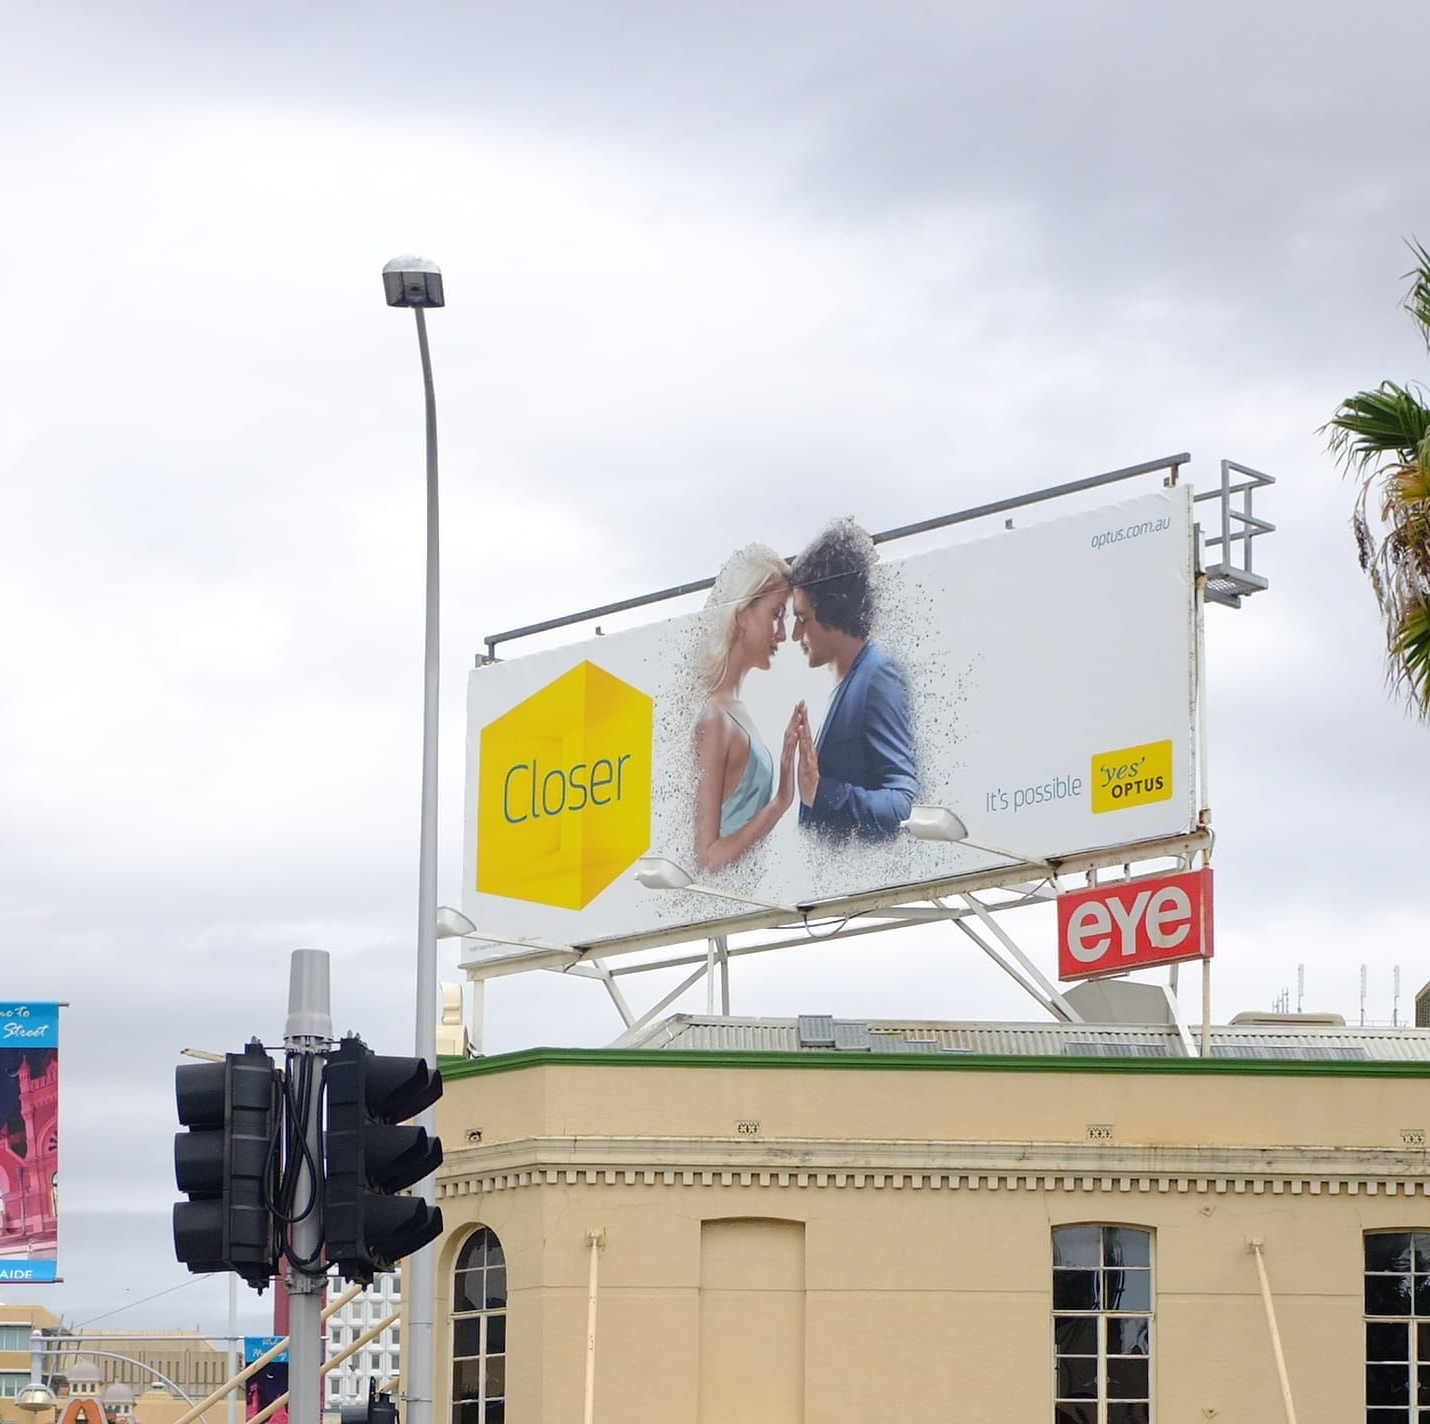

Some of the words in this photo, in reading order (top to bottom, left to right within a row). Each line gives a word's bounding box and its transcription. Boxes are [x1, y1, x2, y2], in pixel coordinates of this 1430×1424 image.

[1091, 516, 1171, 550] optus.com.au
[504, 754, 632, 824] Closer
[986, 788, 1009, 813] It's
[1014, 774, 1083, 814] possible
[1111, 776, 1165, 799] OPTUS
[3, 1022, 49, 1039] Street
